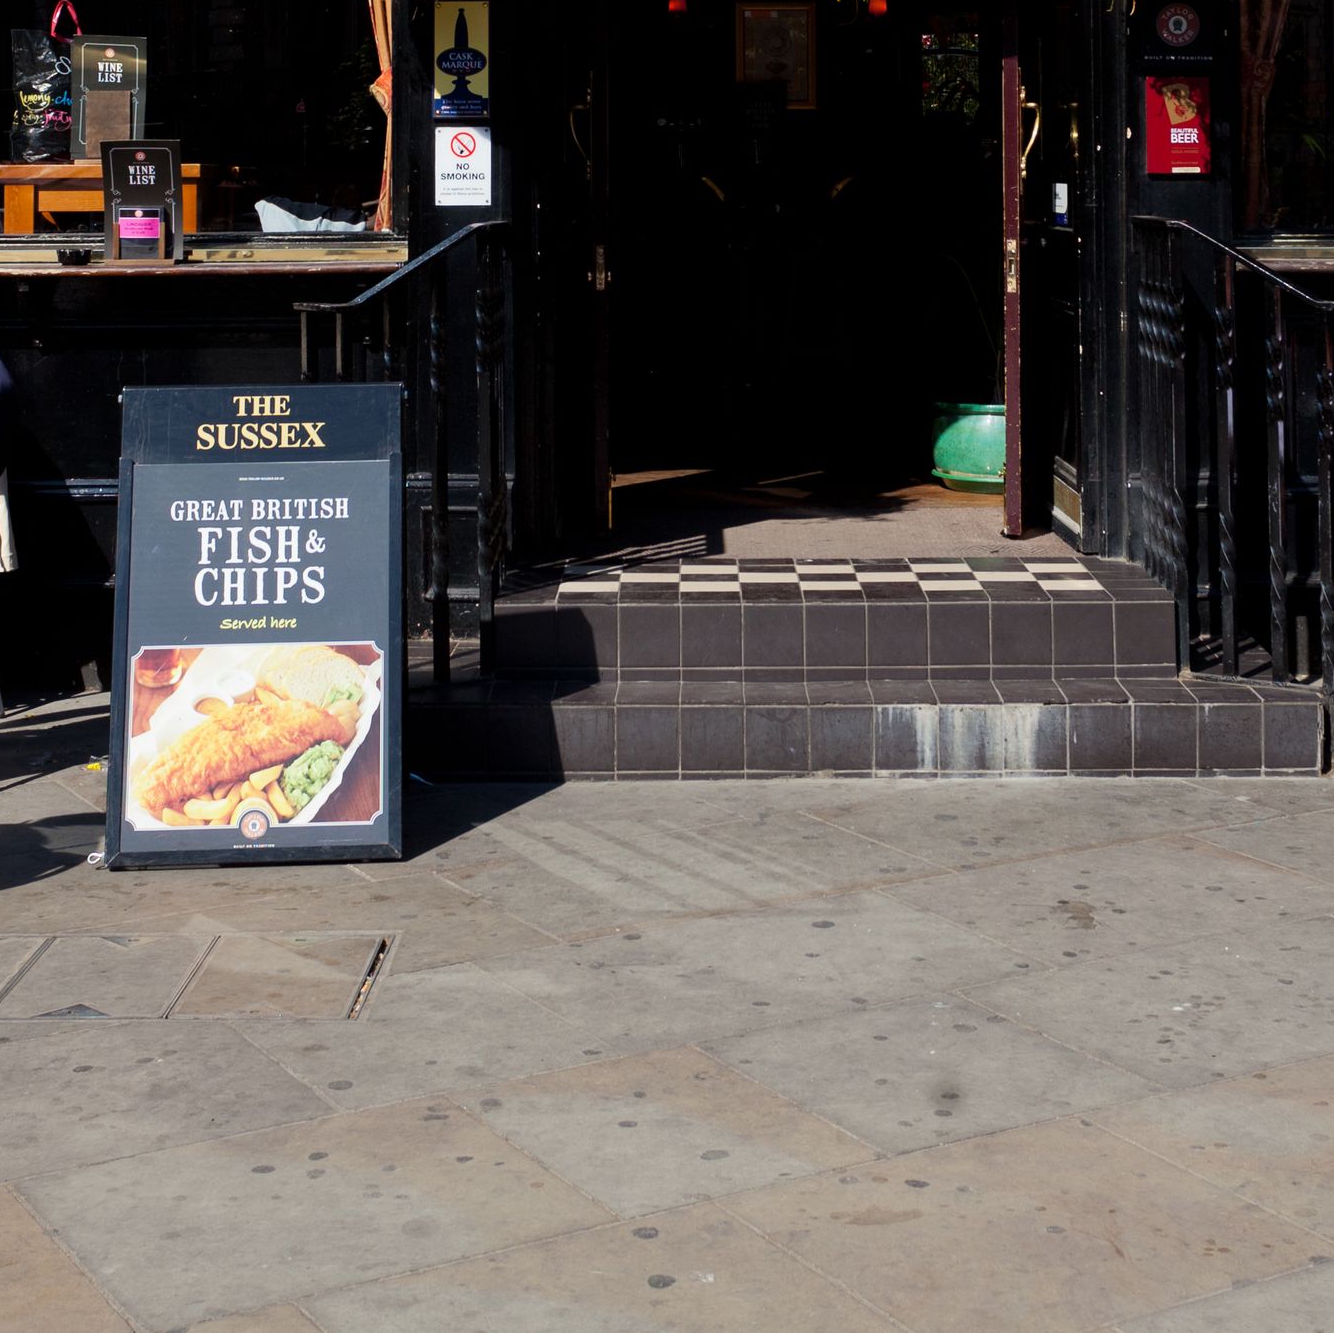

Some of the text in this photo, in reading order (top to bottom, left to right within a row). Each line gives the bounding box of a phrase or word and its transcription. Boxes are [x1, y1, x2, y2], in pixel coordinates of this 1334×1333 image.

[449, 52, 473, 61] CASK
[97, 62, 123, 73] WINE
[442, 60, 483, 70] MARQUE
[97, 73, 122, 83] LIST
[1170, 133, 1199, 144] BEER
[128, 165, 156, 175] WINE
[456, 163, 470, 171] NO
[129, 175, 156, 185] LIST
[440, 172, 485, 180] SMOKING
[232, 395, 291, 417] THE
[196, 422, 326, 450] SUSSEX
[170, 497, 349, 522] GREAT BRITISH
[197, 525, 326, 565] FISH &
[194, 566, 326, 606] CHIPS
[270, 616, 297, 629] here
